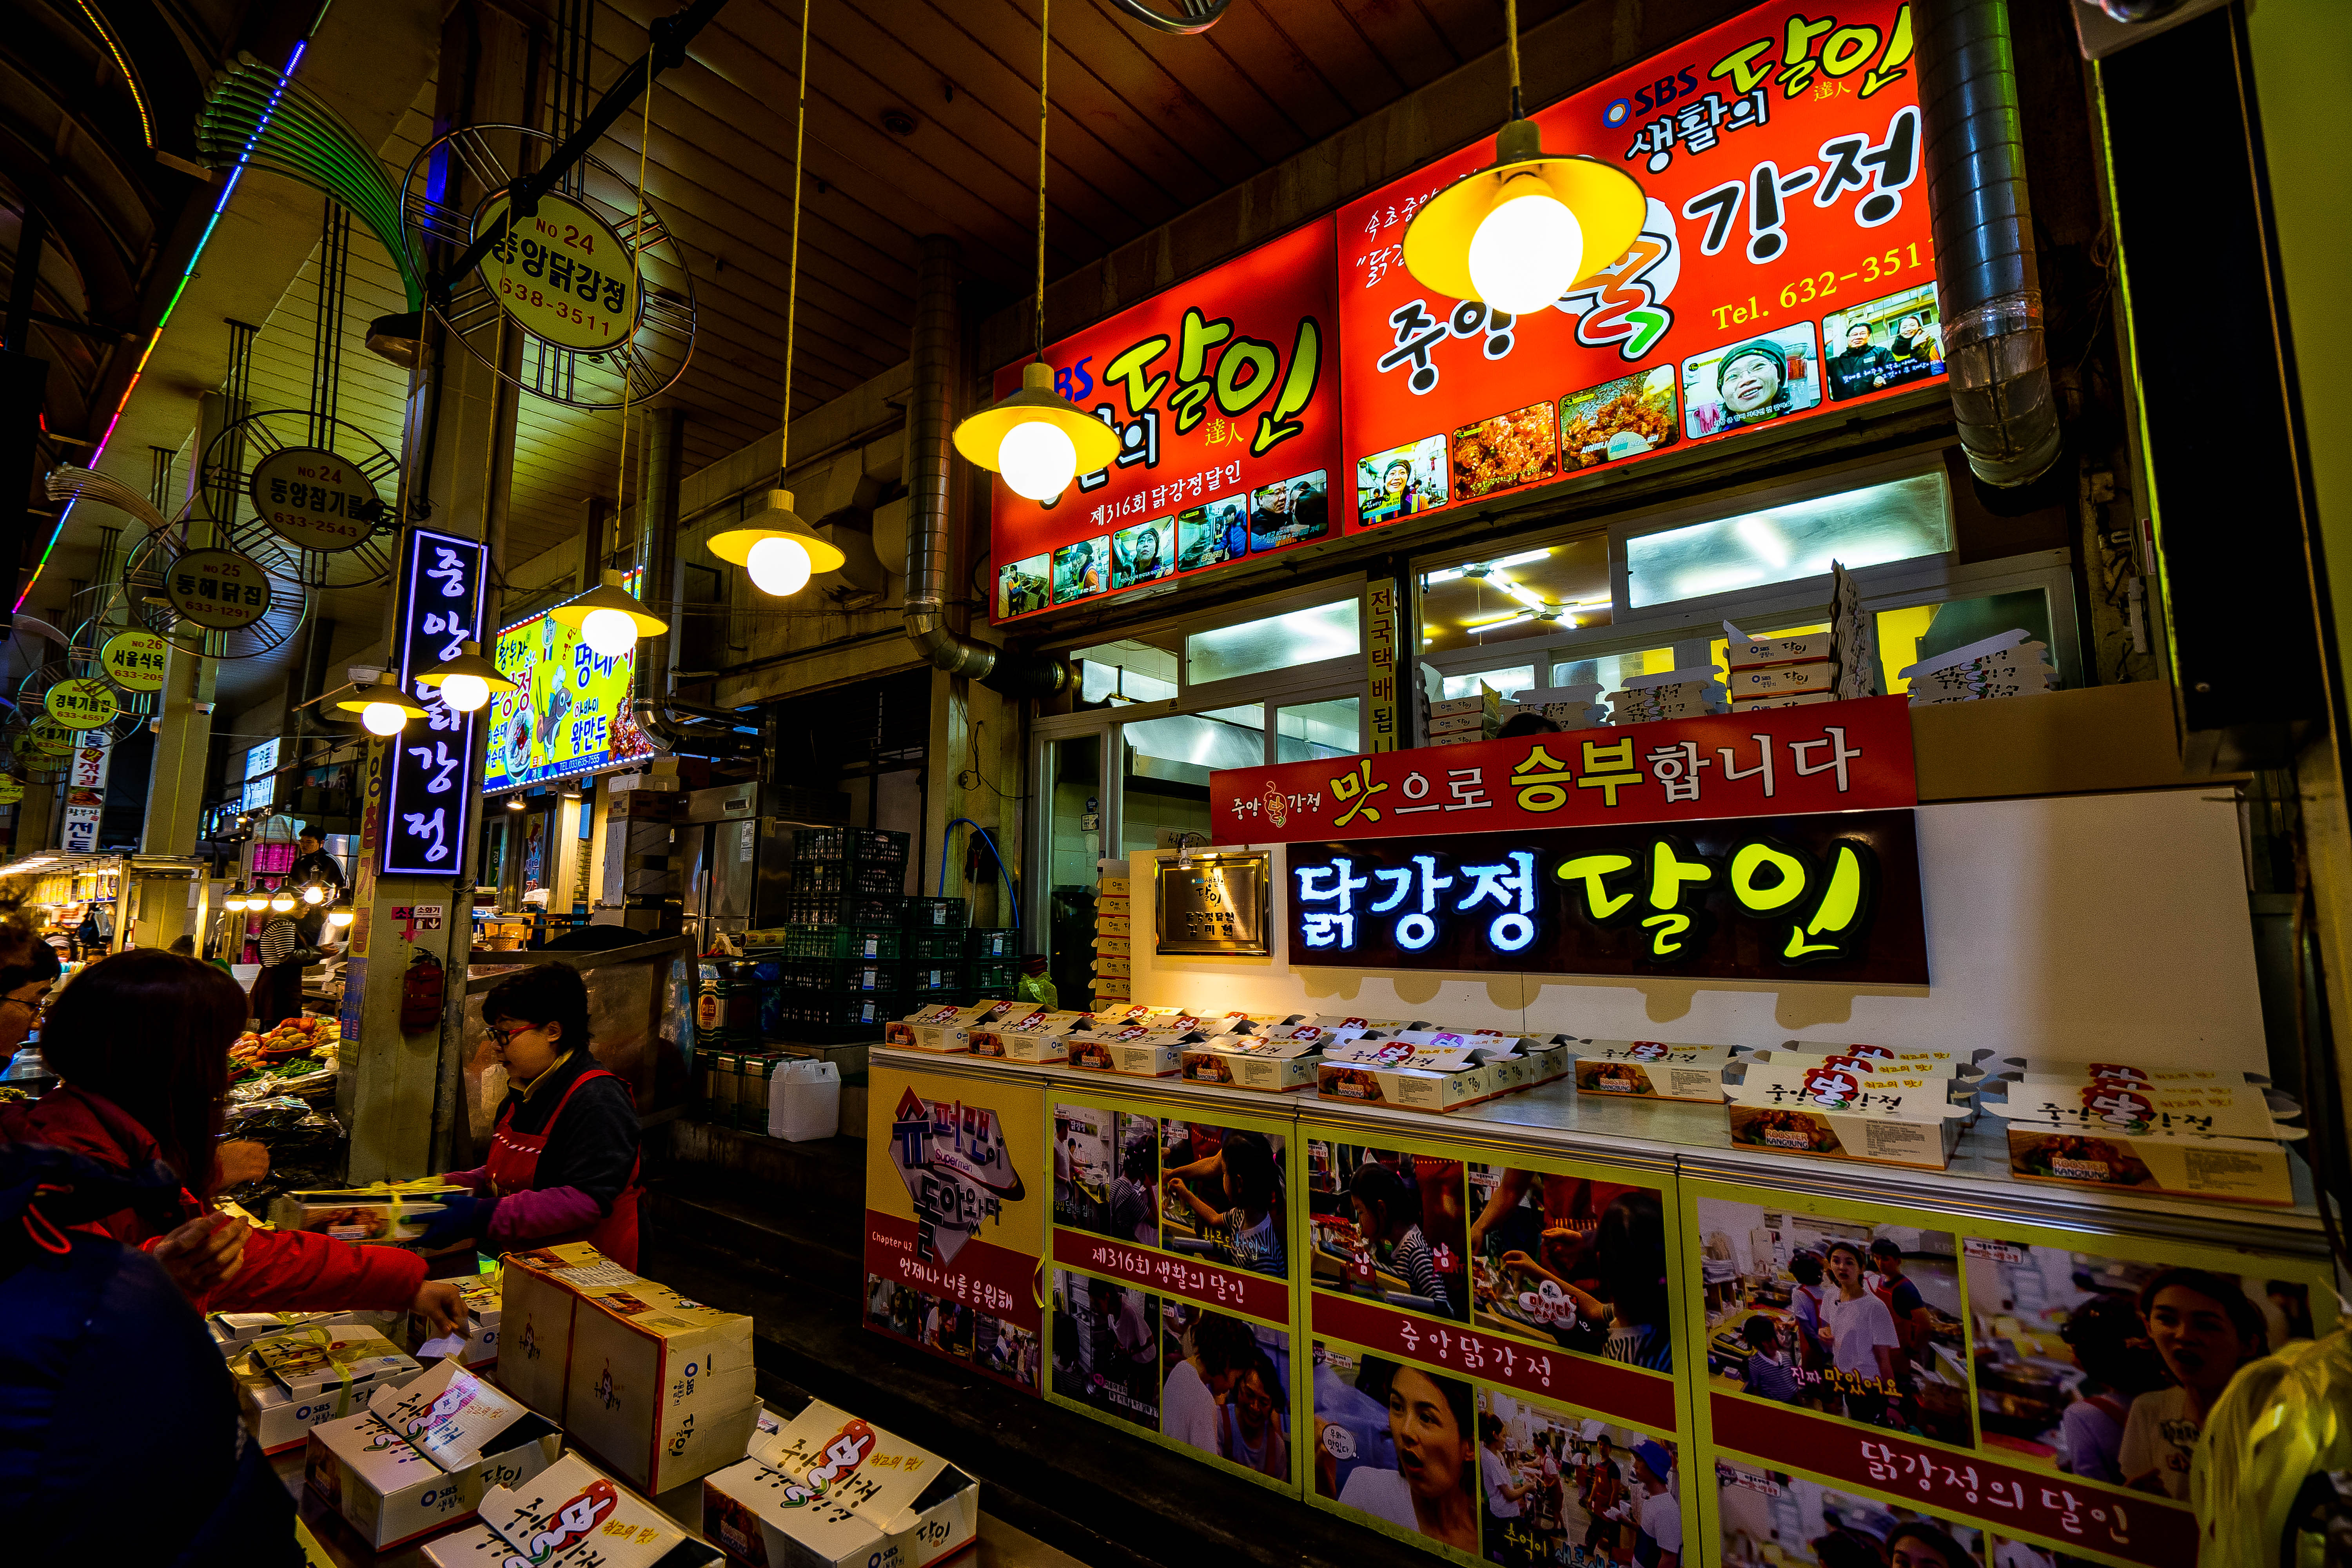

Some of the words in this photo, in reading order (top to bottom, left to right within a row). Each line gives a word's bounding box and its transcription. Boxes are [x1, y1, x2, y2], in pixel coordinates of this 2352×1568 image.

[1708, 2, 1915, 100] 달인
[1634, 63, 1699, 118] SBS
[1624, 89, 1769, 174] 생활의
[535, 218, 558, 238] NO
[564, 224, 595, 255] 24
[492, 230, 626, 314] 중앙닭강정
[499, 277, 610, 336] 638-3511
[1711, 299, 1768, 331] Tel.
[1055, 356, 1094, 402] BS
[1103, 308, 1323, 456] 달인
[1205, 418, 1245, 448] 達人
[298, 466, 315, 478] NO
[319, 465, 342, 485] 24
[1090, 493, 1146, 526] 제316회
[1151, 460, 1241, 509] 닭강정달인
[274, 512, 357, 537] 633-2543
[203, 564, 218, 574] NO
[221, 563, 240, 577] 25
[185, 601, 249, 619] 633-1291
[131, 640, 144, 648] NO
[146, 639, 163, 650] 26
[496, 633, 528, 671] 황부자
[1781, 641, 1807, 654] 달인
[112, 649, 164, 671] 서울식육
[1370, 587, 1394, 753] 전국택배됩니
[114, 669, 164, 682] 633-205
[1783, 671, 1809, 685] 달인
[56, 711, 105, 722] 633-4551
[574, 698, 599, 718] 아바이
[571, 715, 607, 755] 왕만두
[1330, 759, 1493, 830] 맛으로
[1510, 726, 1861, 815] 승부합니다
[416, 906, 440, 915] 소화기
[1294, 852, 1538, 951] 닭강정
[1557, 842, 1860, 958] 달인
[1600, 1078, 1631, 1086] ROOSTER
[1879, 1065, 1910, 1074] 최고의
[1338, 1082, 1364, 1091] ROOSTER
[1765, 1069, 1902, 1111] 중앙닭강정
[1864, 1080, 1897, 1089] 최고의
[892, 1084, 1005, 1170] 슈퍼맨이
[1765, 1129, 1808, 1141] ROOSTER
[935, 1148, 973, 1172] Superman
[913, 1172, 1002, 1264] 돌아왔다
[872, 1230, 902, 1249] Chapter
[903, 1240, 913, 1252] 42
[1202, 1227, 1232, 1249] 하루도
[1354, 1252, 1370, 1276] 냠
[1433, 1242, 1449, 1268] 냠
[900, 1257, 939, 1284] 언제나
[944, 1273, 968, 1299] 너를
[972, 1280, 1013, 1311] 응원해
[1093, 1247, 1149, 1276] 제316회
[1155, 1261, 1204, 1290] 생활의
[1210, 1274, 1244, 1304] 달인
[1401, 1320, 1551, 1387] 중앙닭강정
[684, 1377, 696, 1396] SBS
[1791, 1366, 1822, 1386] 진짜
[1824, 1365, 1904, 1398] 맛있어요
[314, 1402, 330, 1412] SBS
[1327, 1439, 1350, 1455] 맛있다
[780, 1433, 884, 1508] 중앙닭강정
[869, 1451, 902, 1469] 최고의
[904, 1457, 924, 1472] 맛!
[439, 1483, 458, 1499] SBS
[480, 1464, 523, 1485] 달인
[1861, 1440, 2024, 1510] 닭강정의
[2041, 1489, 2129, 1544] 달인
[437, 1494, 465, 1513] 생활의
[603, 1518, 637, 1541] 최고의
[636, 1527, 659, 1544] 맛!
[883, 1544, 899, 1561] SBS
[916, 1520, 950, 1547] 달인
[1503, 1523, 1547, 1562] 추억이
